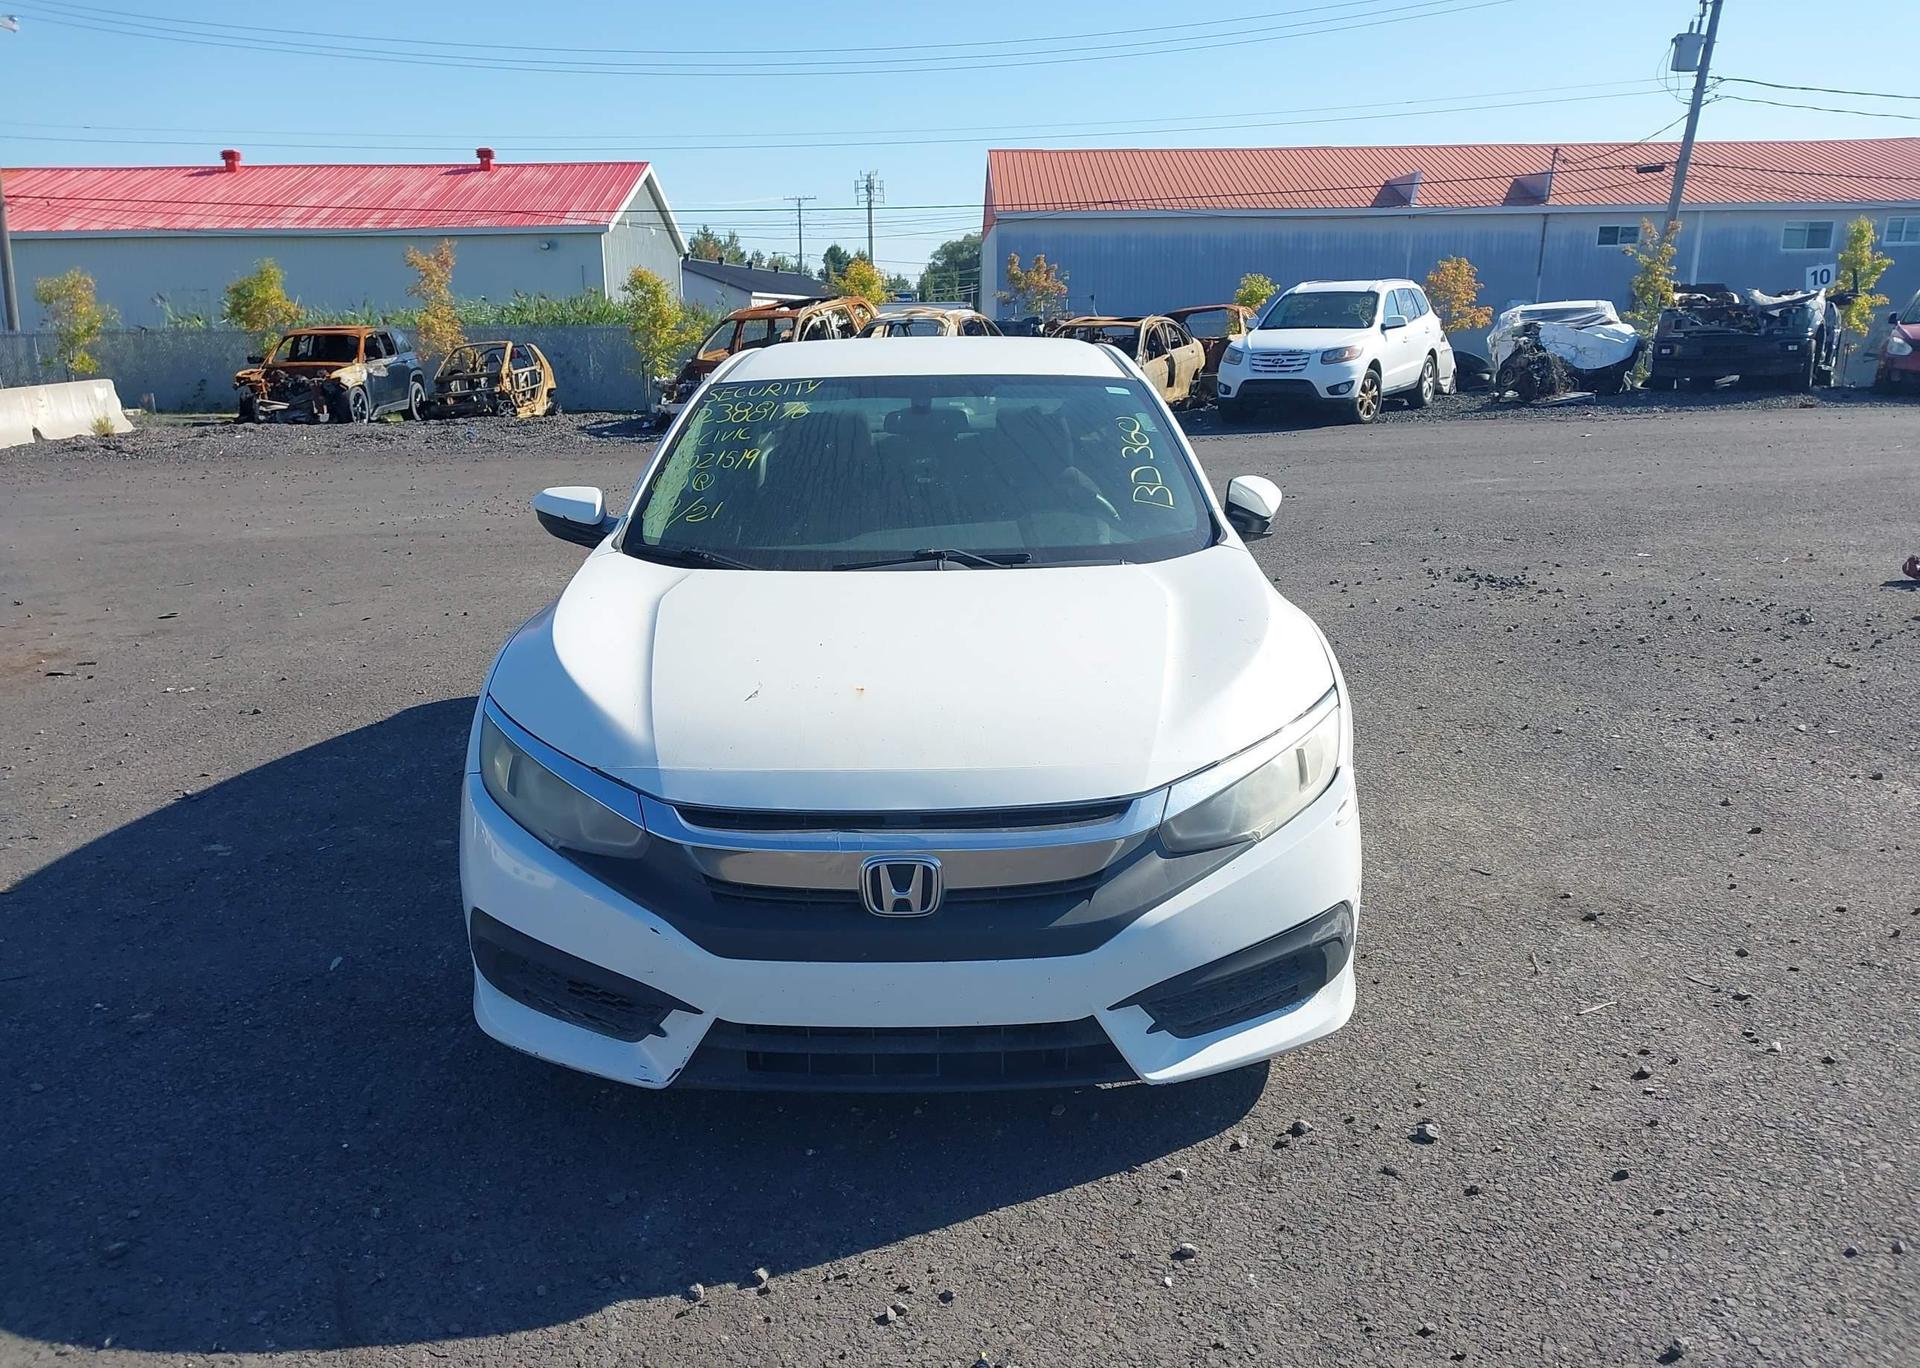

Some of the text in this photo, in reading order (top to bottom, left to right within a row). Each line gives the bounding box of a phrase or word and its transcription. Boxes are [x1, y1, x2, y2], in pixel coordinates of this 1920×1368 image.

[1810, 268, 1831, 286] 10
[703, 380, 824, 402] SECURITY
[698, 426, 752, 446] CIVIC
[1115, 416, 1176, 510] BD 360
